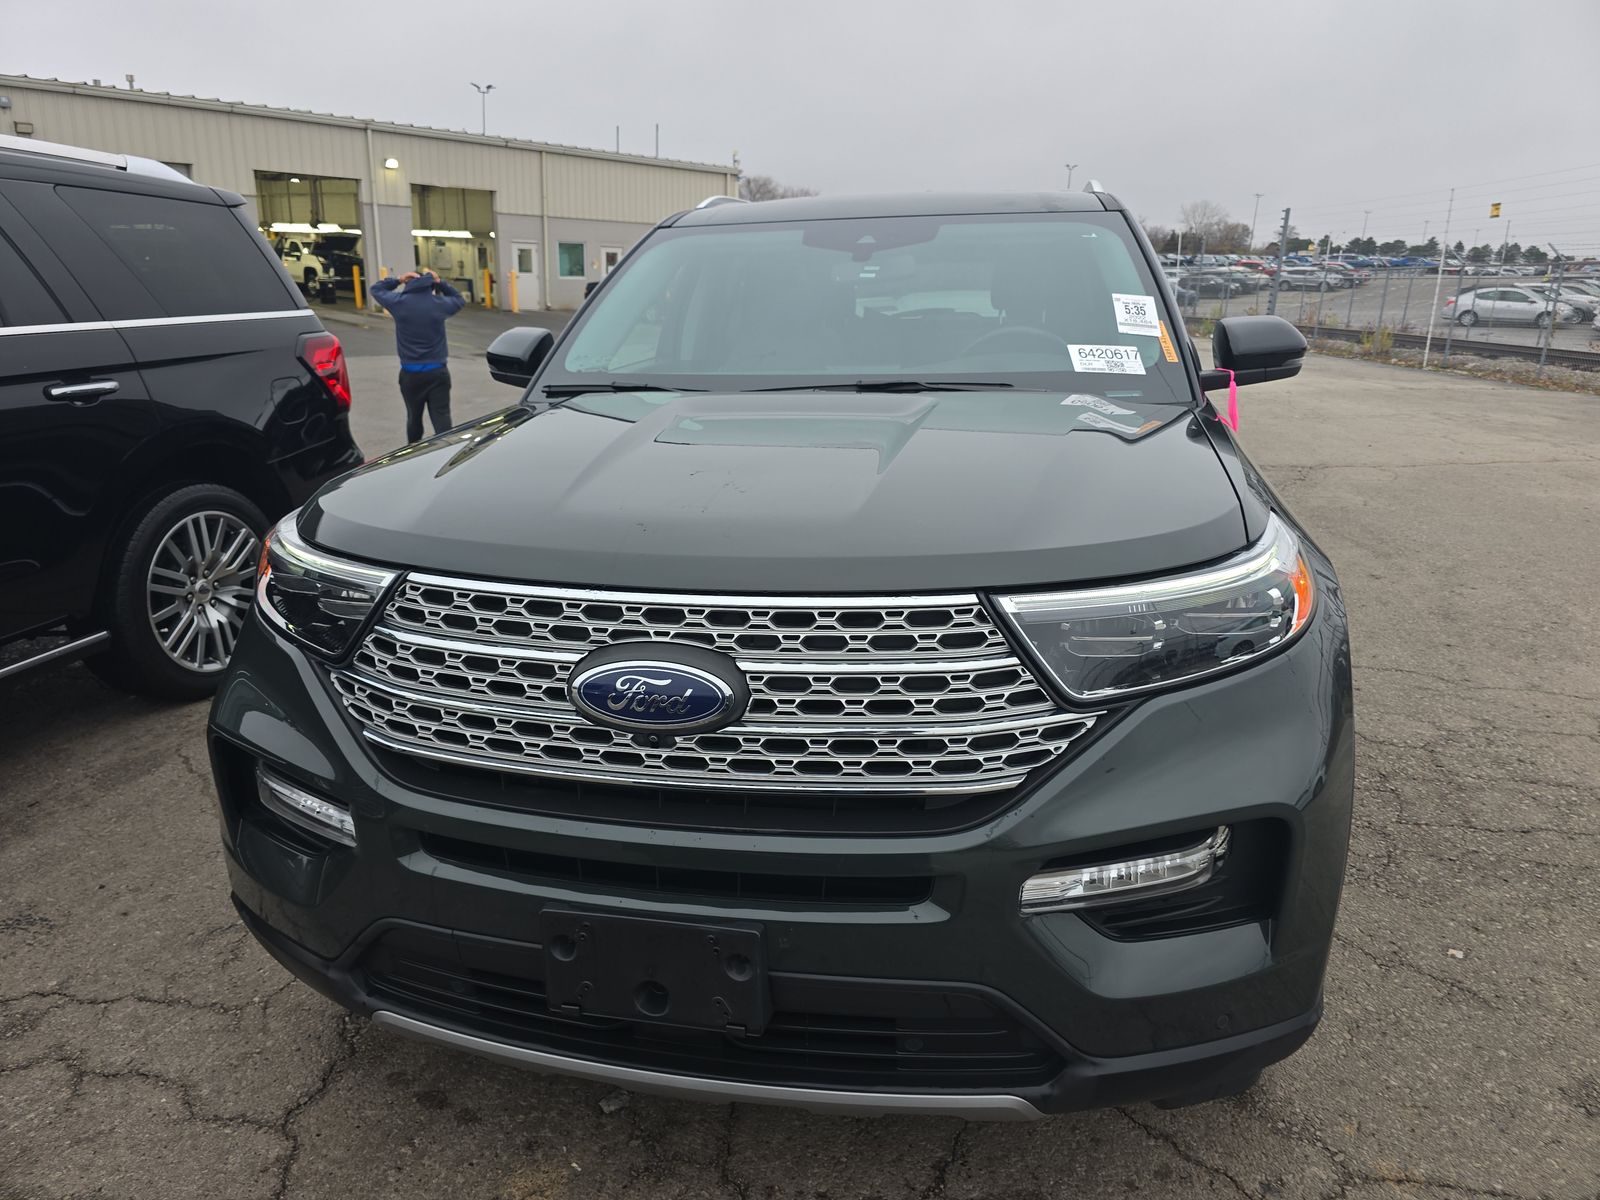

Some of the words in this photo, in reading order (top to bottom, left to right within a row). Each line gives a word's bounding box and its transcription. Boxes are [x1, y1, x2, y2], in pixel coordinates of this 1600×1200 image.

[1124, 304, 1146, 316] 5:35
[1078, 347, 1138, 360] 6420617
[607, 675, 693, 714] Ford
